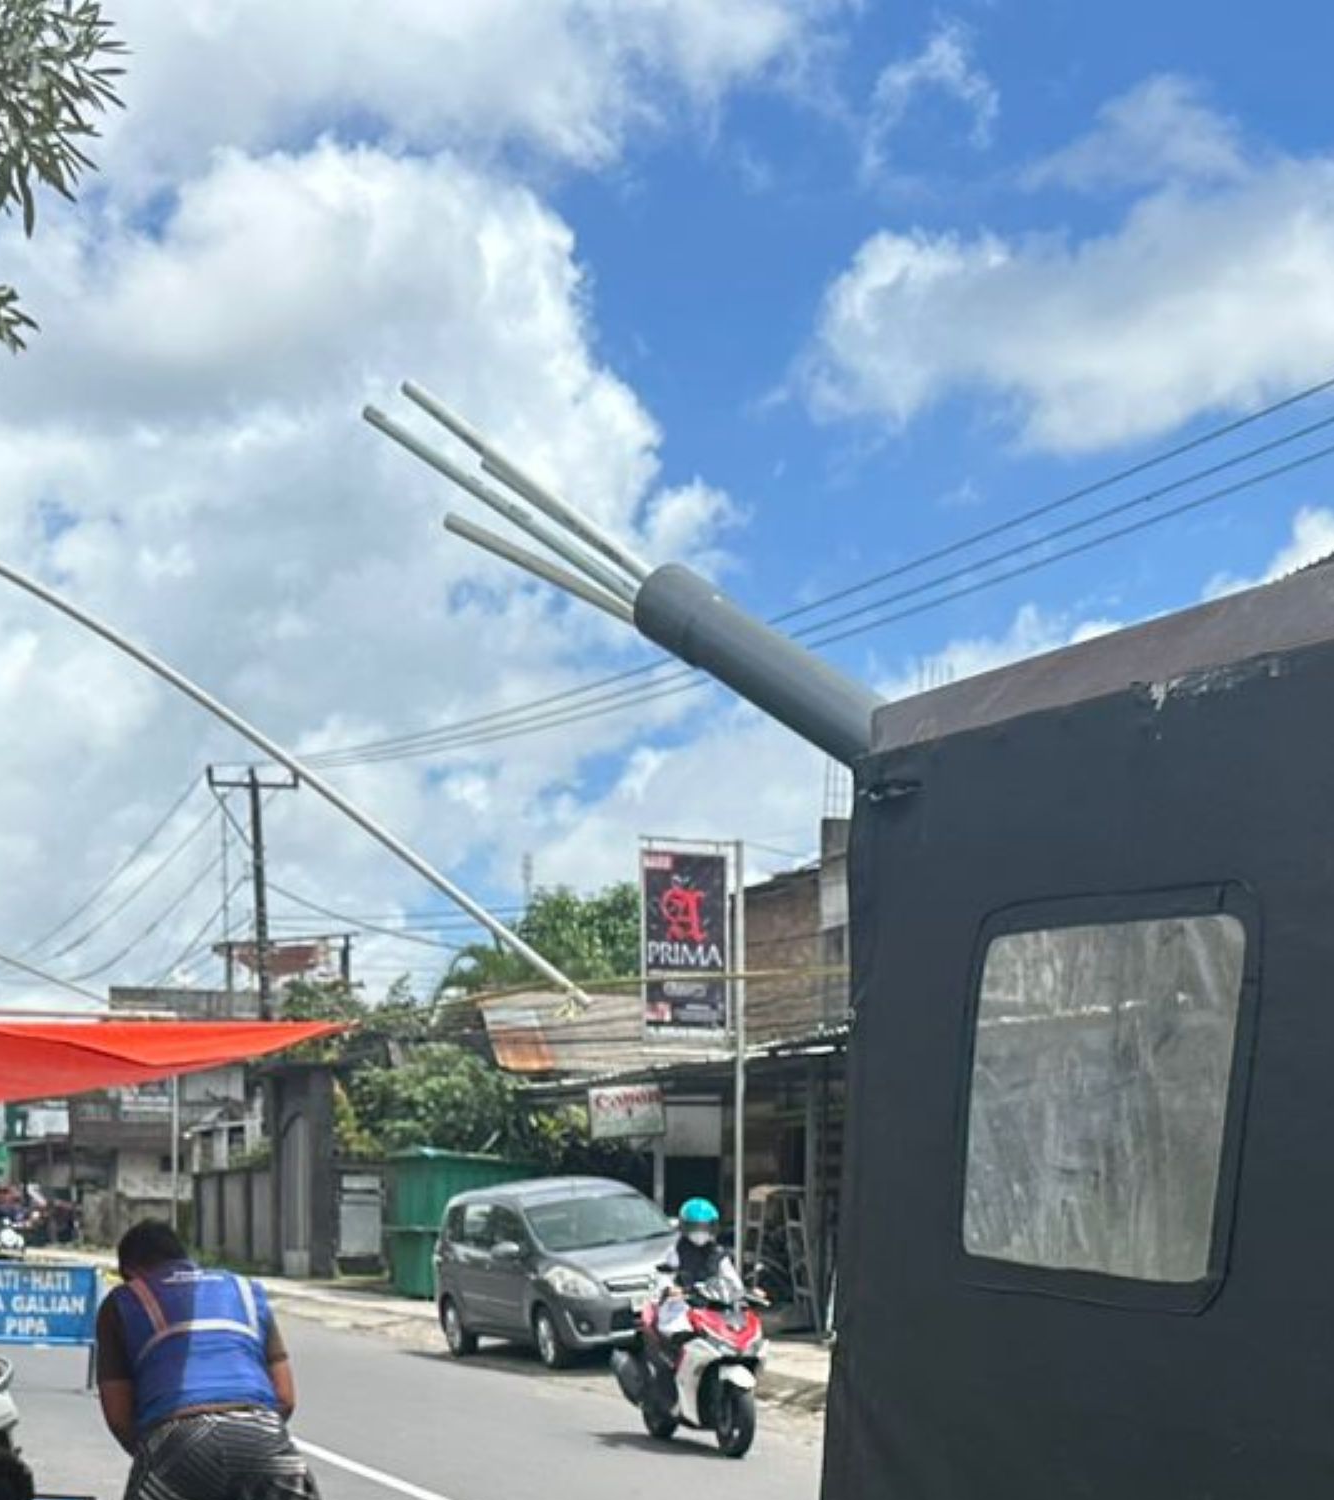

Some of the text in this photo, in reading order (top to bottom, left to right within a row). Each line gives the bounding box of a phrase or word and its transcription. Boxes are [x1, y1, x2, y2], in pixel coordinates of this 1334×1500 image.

[646, 940, 723, 968] PRIMA
[10, 1294, 87, 1316] GALIAN
[4, 1315, 49, 1336] PIPA
